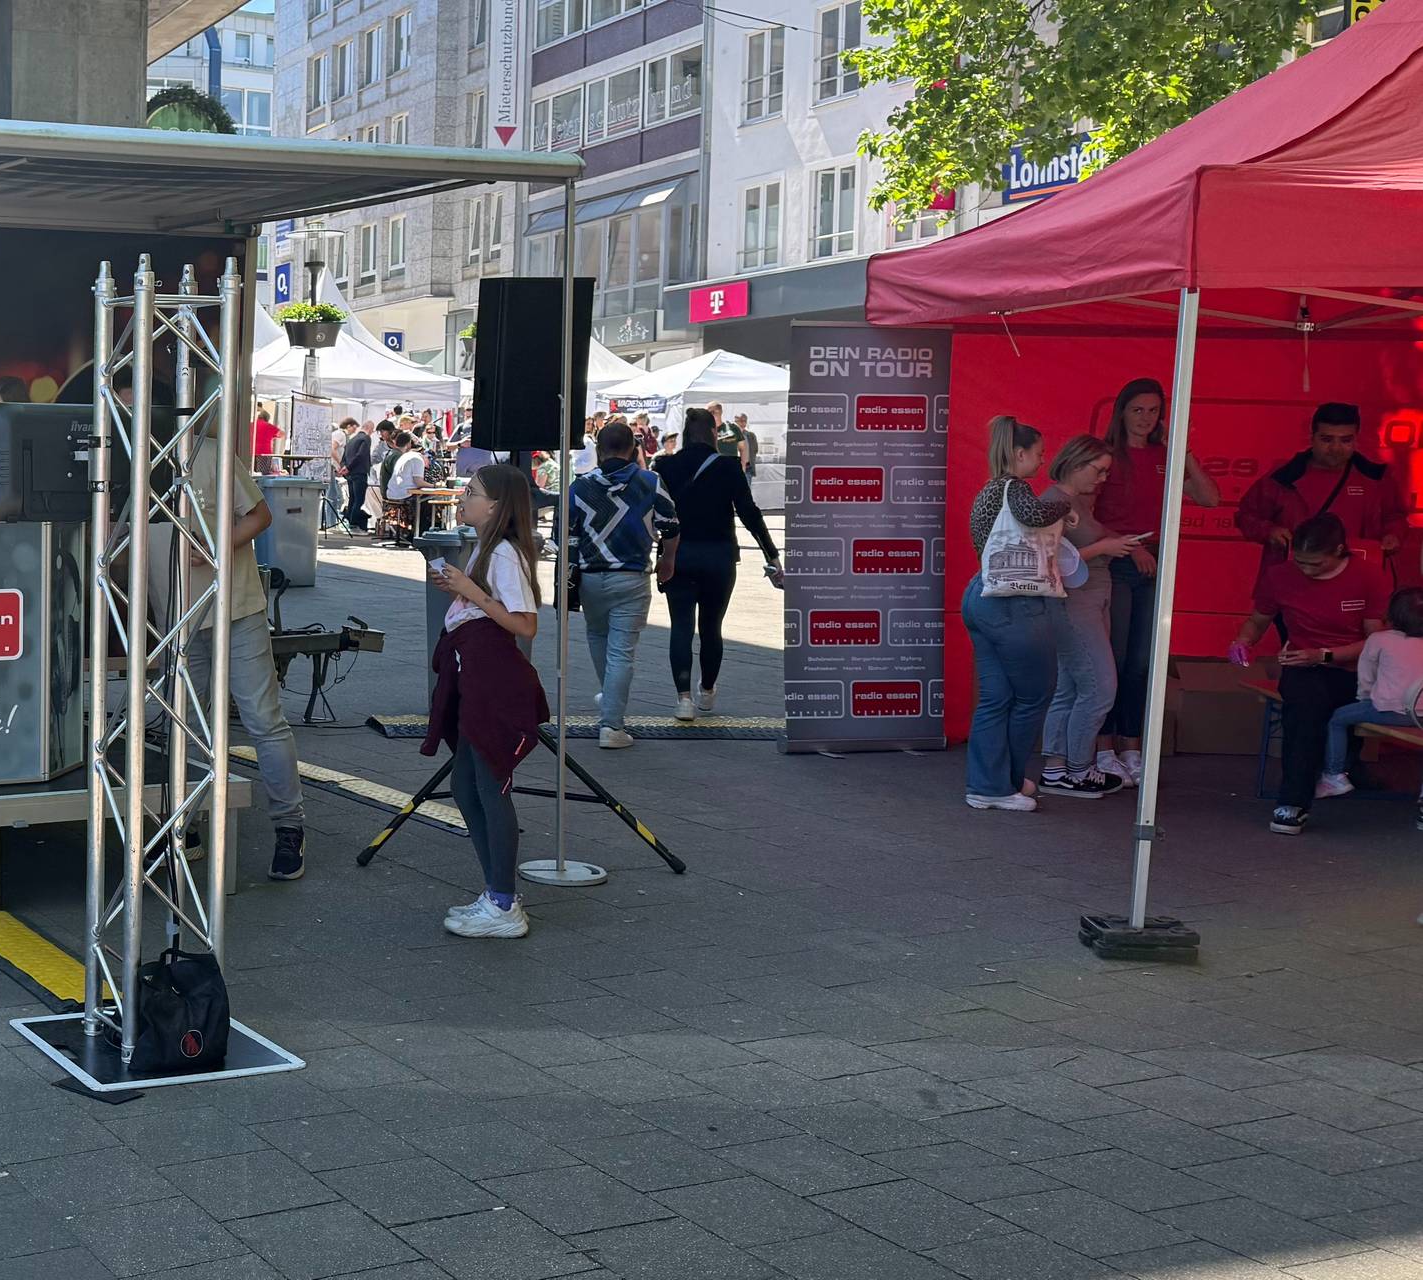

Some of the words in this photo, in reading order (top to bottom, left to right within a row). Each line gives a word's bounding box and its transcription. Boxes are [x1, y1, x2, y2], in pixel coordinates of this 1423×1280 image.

[497, 0, 514, 122] Mieterschutzbund
[809, 346, 860, 359] DEIN
[867, 347, 933, 360] RADIO
[809, 361, 850, 377] ON
[859, 361, 933, 378] TOUR
[788, 405, 807, 413] dio
[859, 405, 888, 414] radio
[815, 477, 844, 486] radio
[847, 478, 880, 486] essen
[895, 477, 924, 486] radio
[786, 549, 803, 557] dio
[855, 549, 884, 557] radio
[1009, 582, 1039, 591] Berlin
[813, 620, 841, 629] radio
[845, 621, 877, 629] essen
[892, 620, 921, 629] radio
[924, 621, 945, 629] ess
[855, 691, 883, 700] radio
[886, 692, 918, 700] essen
